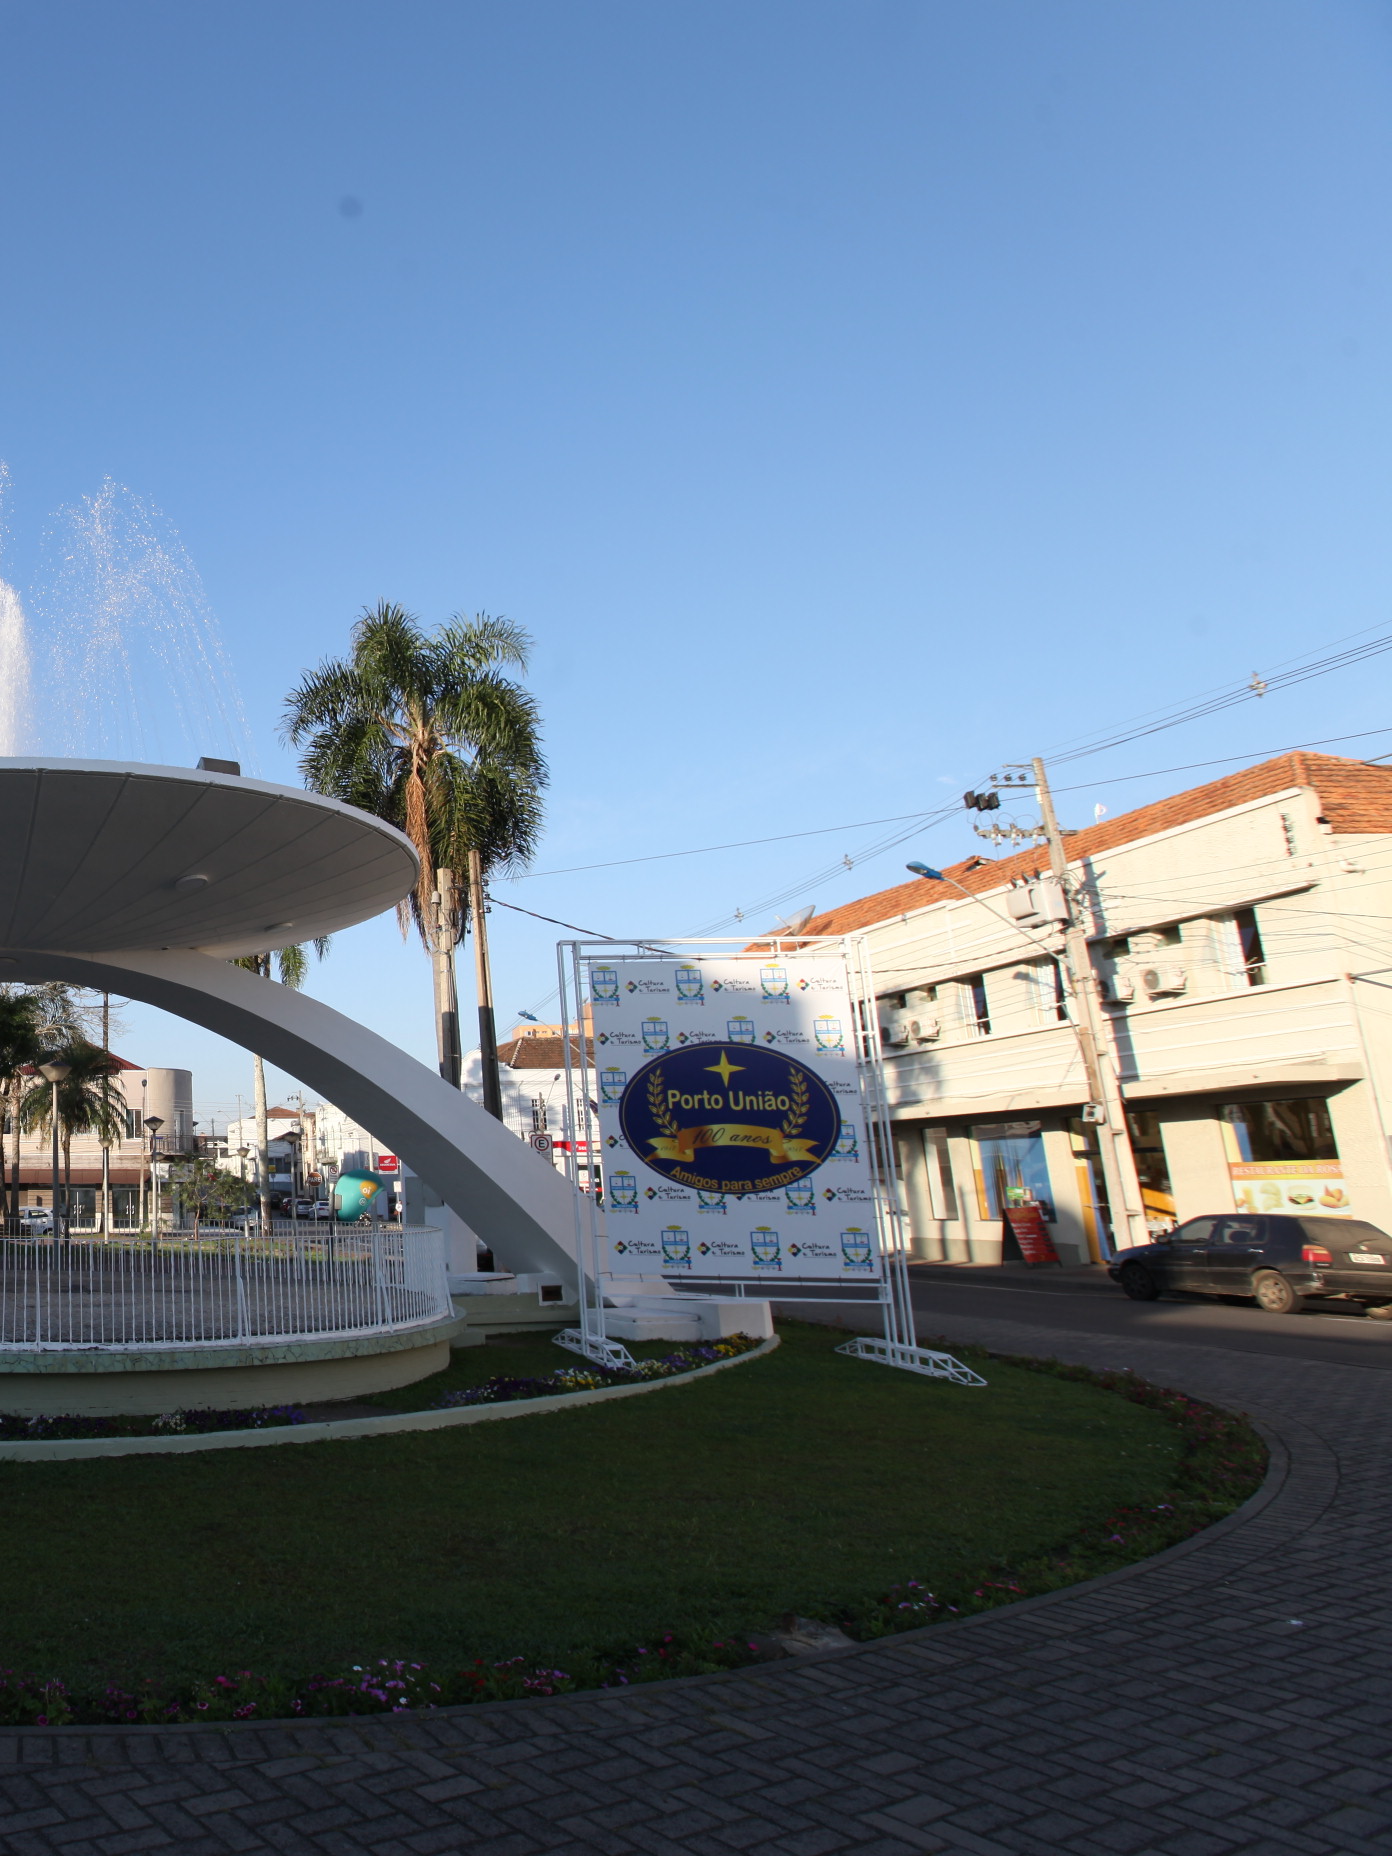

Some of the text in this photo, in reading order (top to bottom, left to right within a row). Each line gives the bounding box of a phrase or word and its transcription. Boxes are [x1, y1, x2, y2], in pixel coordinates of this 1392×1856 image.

[667, 1089, 790, 1110] Porto União
[692, 1127, 773, 1145] 100 anos
[670, 1166, 802, 1191] Amigos para sempre
